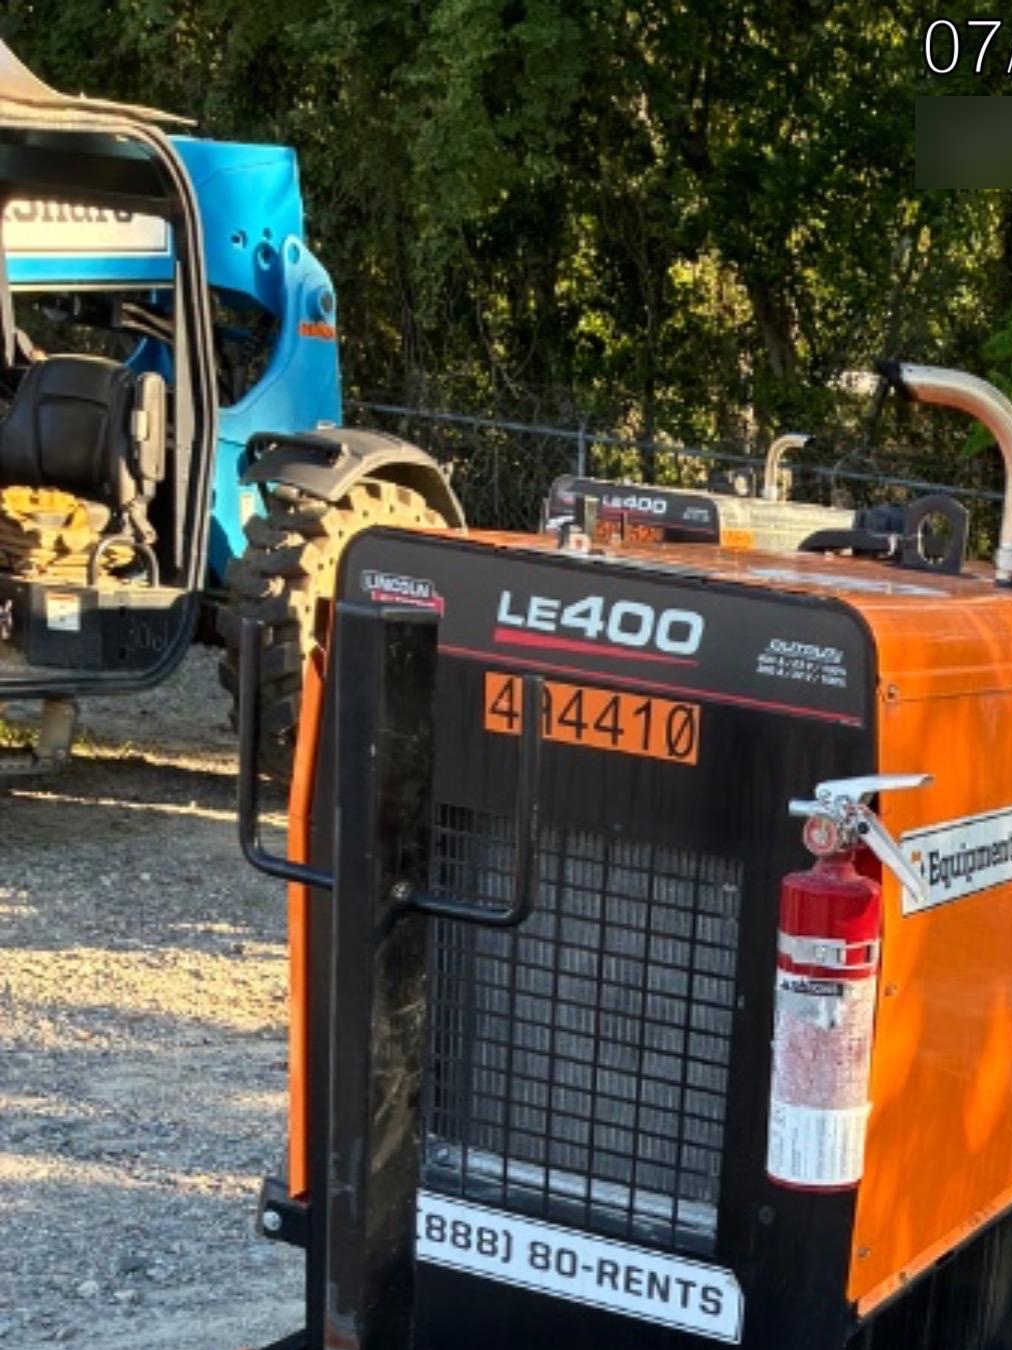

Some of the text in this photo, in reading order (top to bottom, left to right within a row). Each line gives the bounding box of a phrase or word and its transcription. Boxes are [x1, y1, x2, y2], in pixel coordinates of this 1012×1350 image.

[497, 590, 704, 656] LE400
[417, 1208, 724, 1317] 888) 80-RENTS
